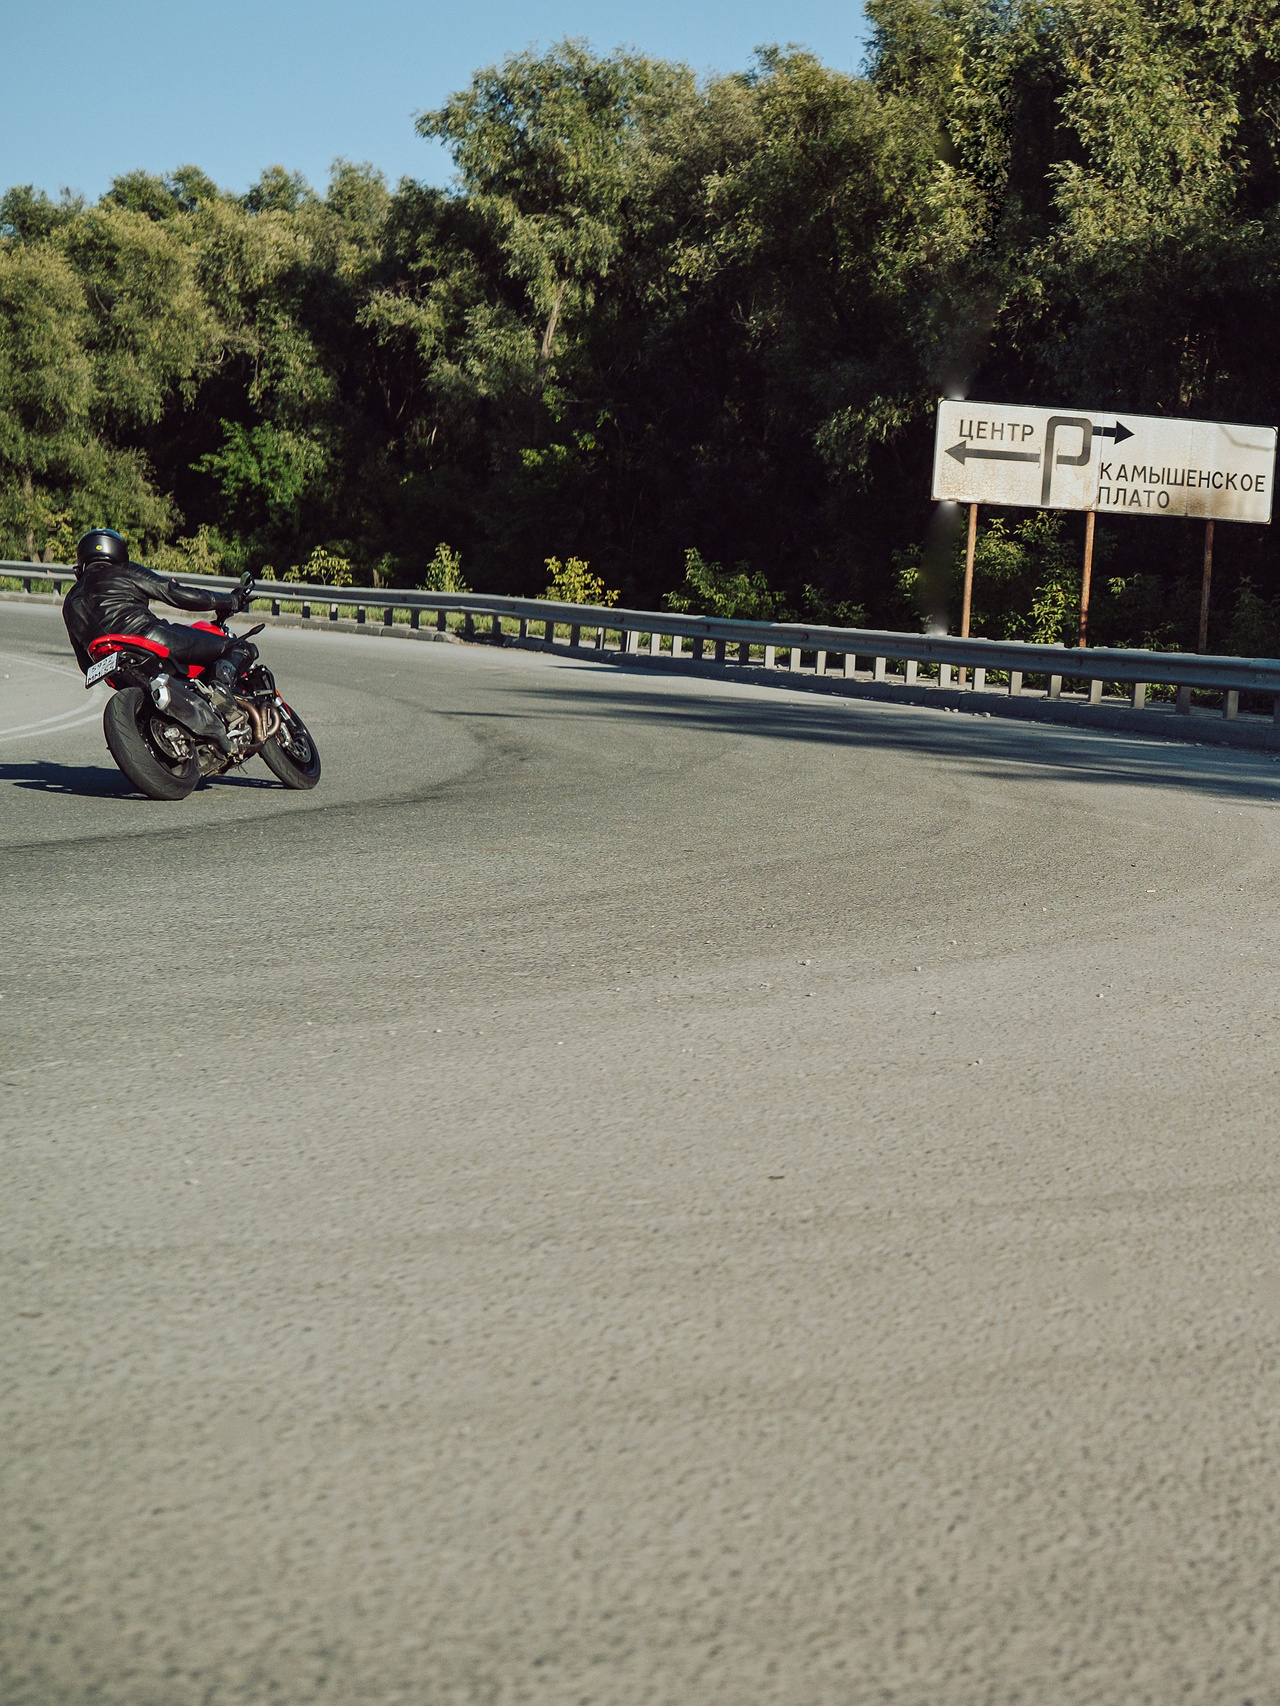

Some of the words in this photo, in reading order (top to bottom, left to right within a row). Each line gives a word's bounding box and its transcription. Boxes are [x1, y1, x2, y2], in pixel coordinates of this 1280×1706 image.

[958, 418, 1035, 442] ЦЕНТР
[1099, 462, 1266, 493] КАМЫШЕНСКОЕ
[1098, 486, 1171, 509] ПЛАТО
